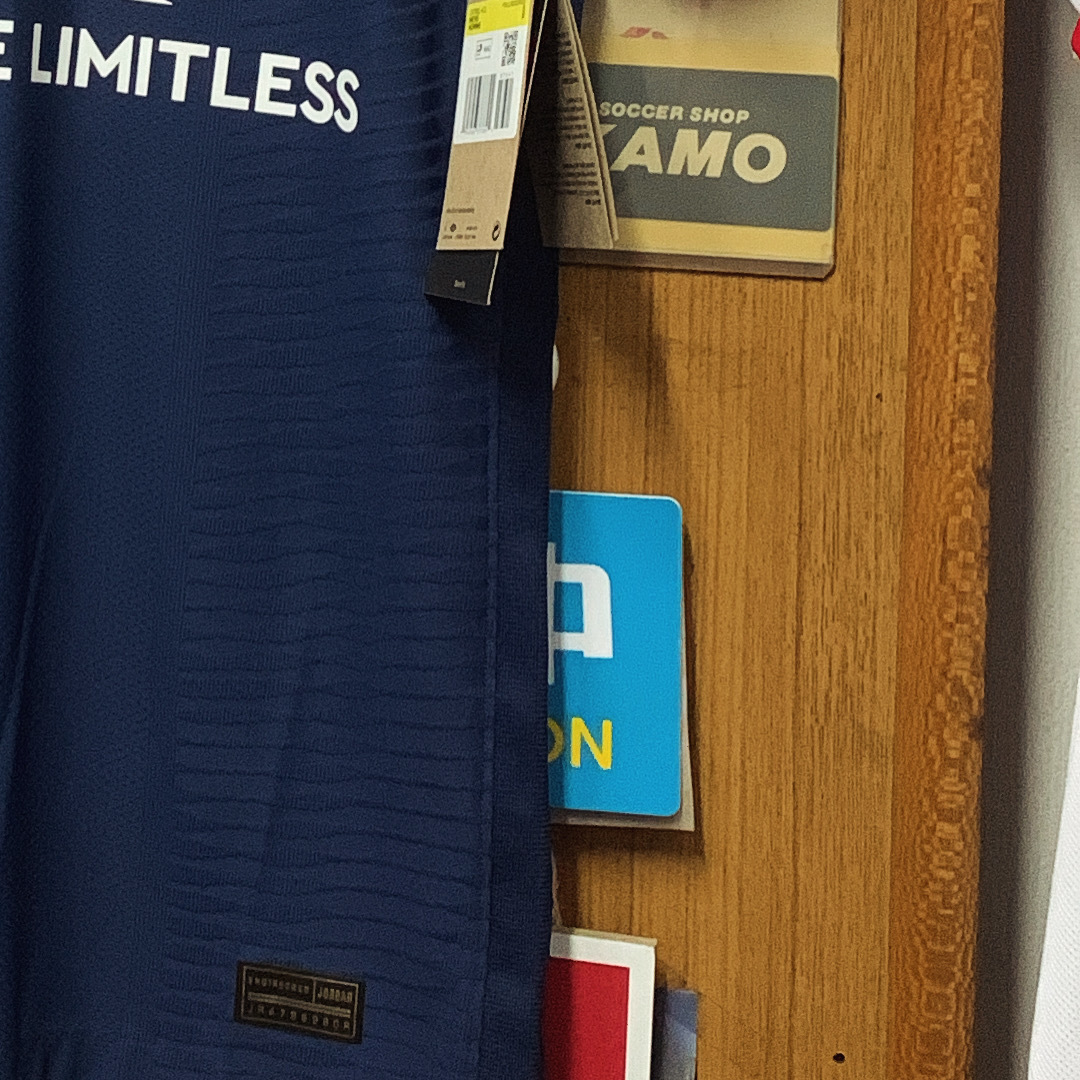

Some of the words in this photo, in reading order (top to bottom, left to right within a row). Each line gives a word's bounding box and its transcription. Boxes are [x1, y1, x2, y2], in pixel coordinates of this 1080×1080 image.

[30, 22, 359, 134] LIMITLESS
[599, 101, 684, 121] SOCCER
[690, 107, 750, 125] SHOP
